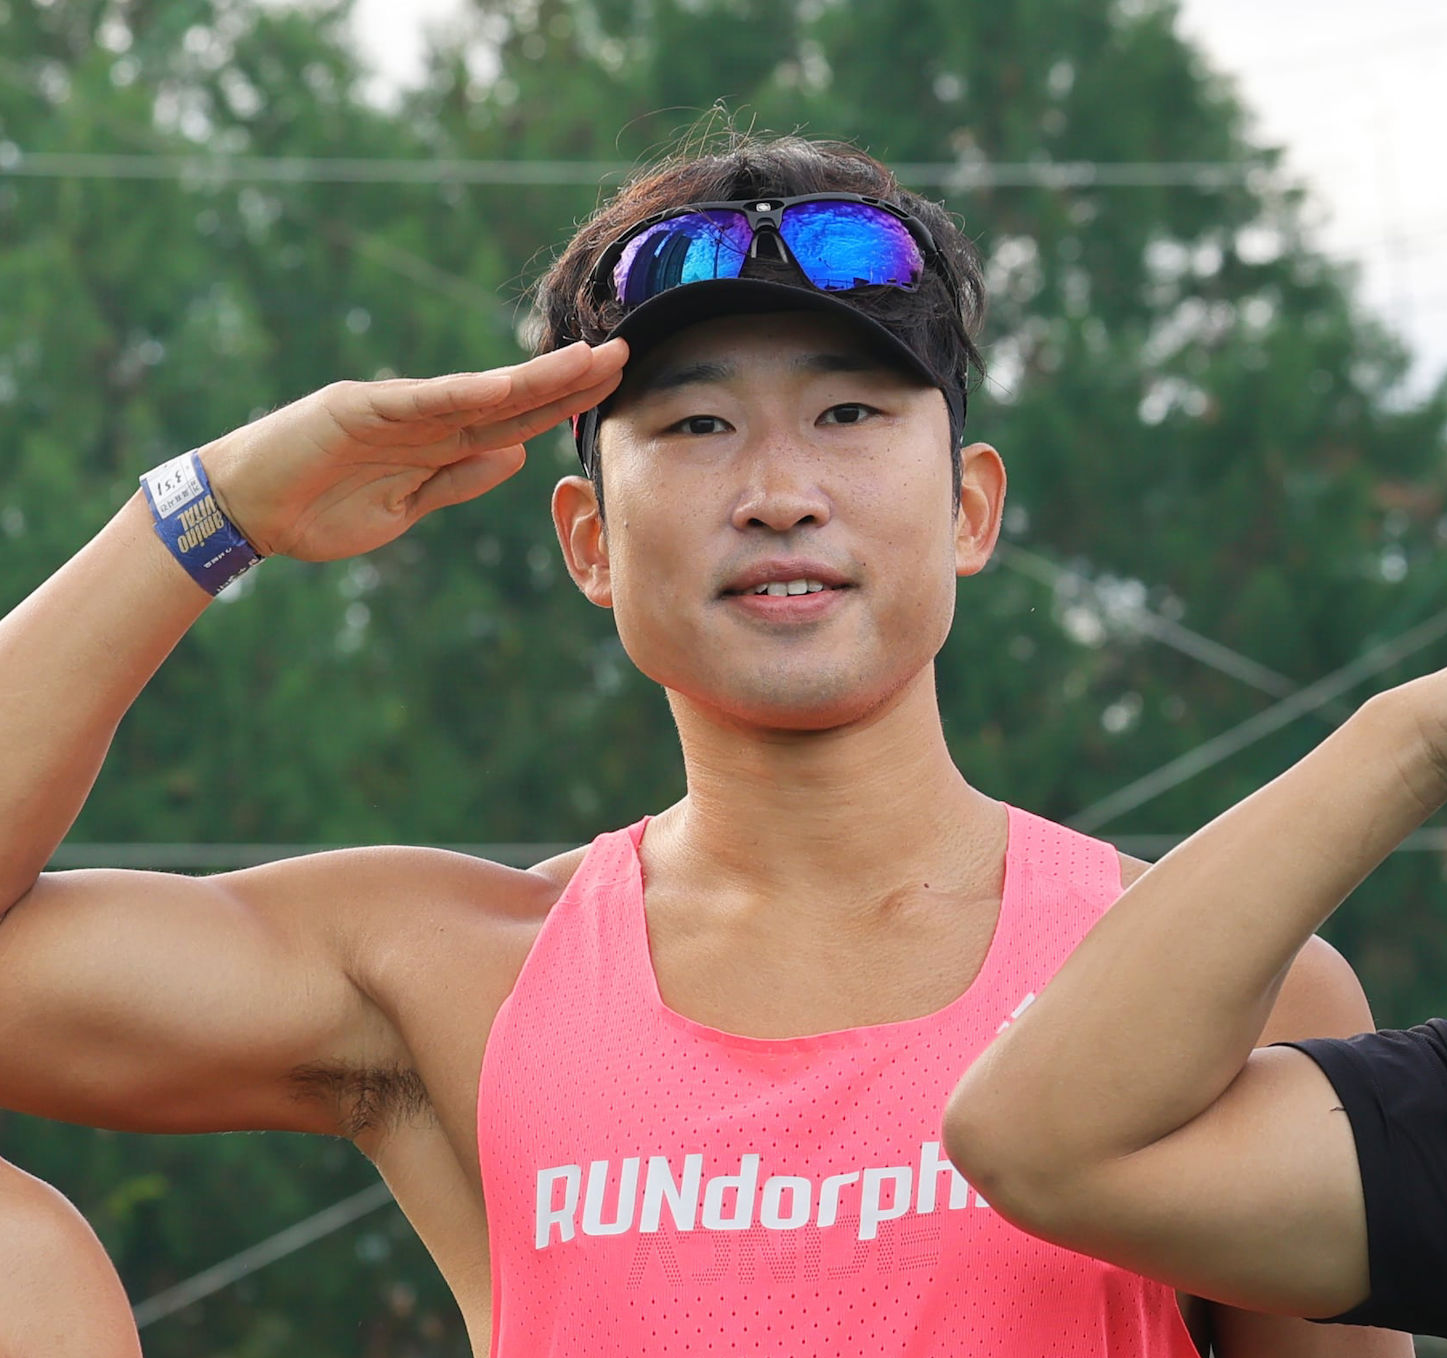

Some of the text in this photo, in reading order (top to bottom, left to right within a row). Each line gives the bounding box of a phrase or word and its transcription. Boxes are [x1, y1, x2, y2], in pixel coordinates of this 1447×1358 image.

[177, 494, 218, 531] VITAL
[178, 511, 224, 553] amino
[535, 1141, 990, 1250] RUNdorph
